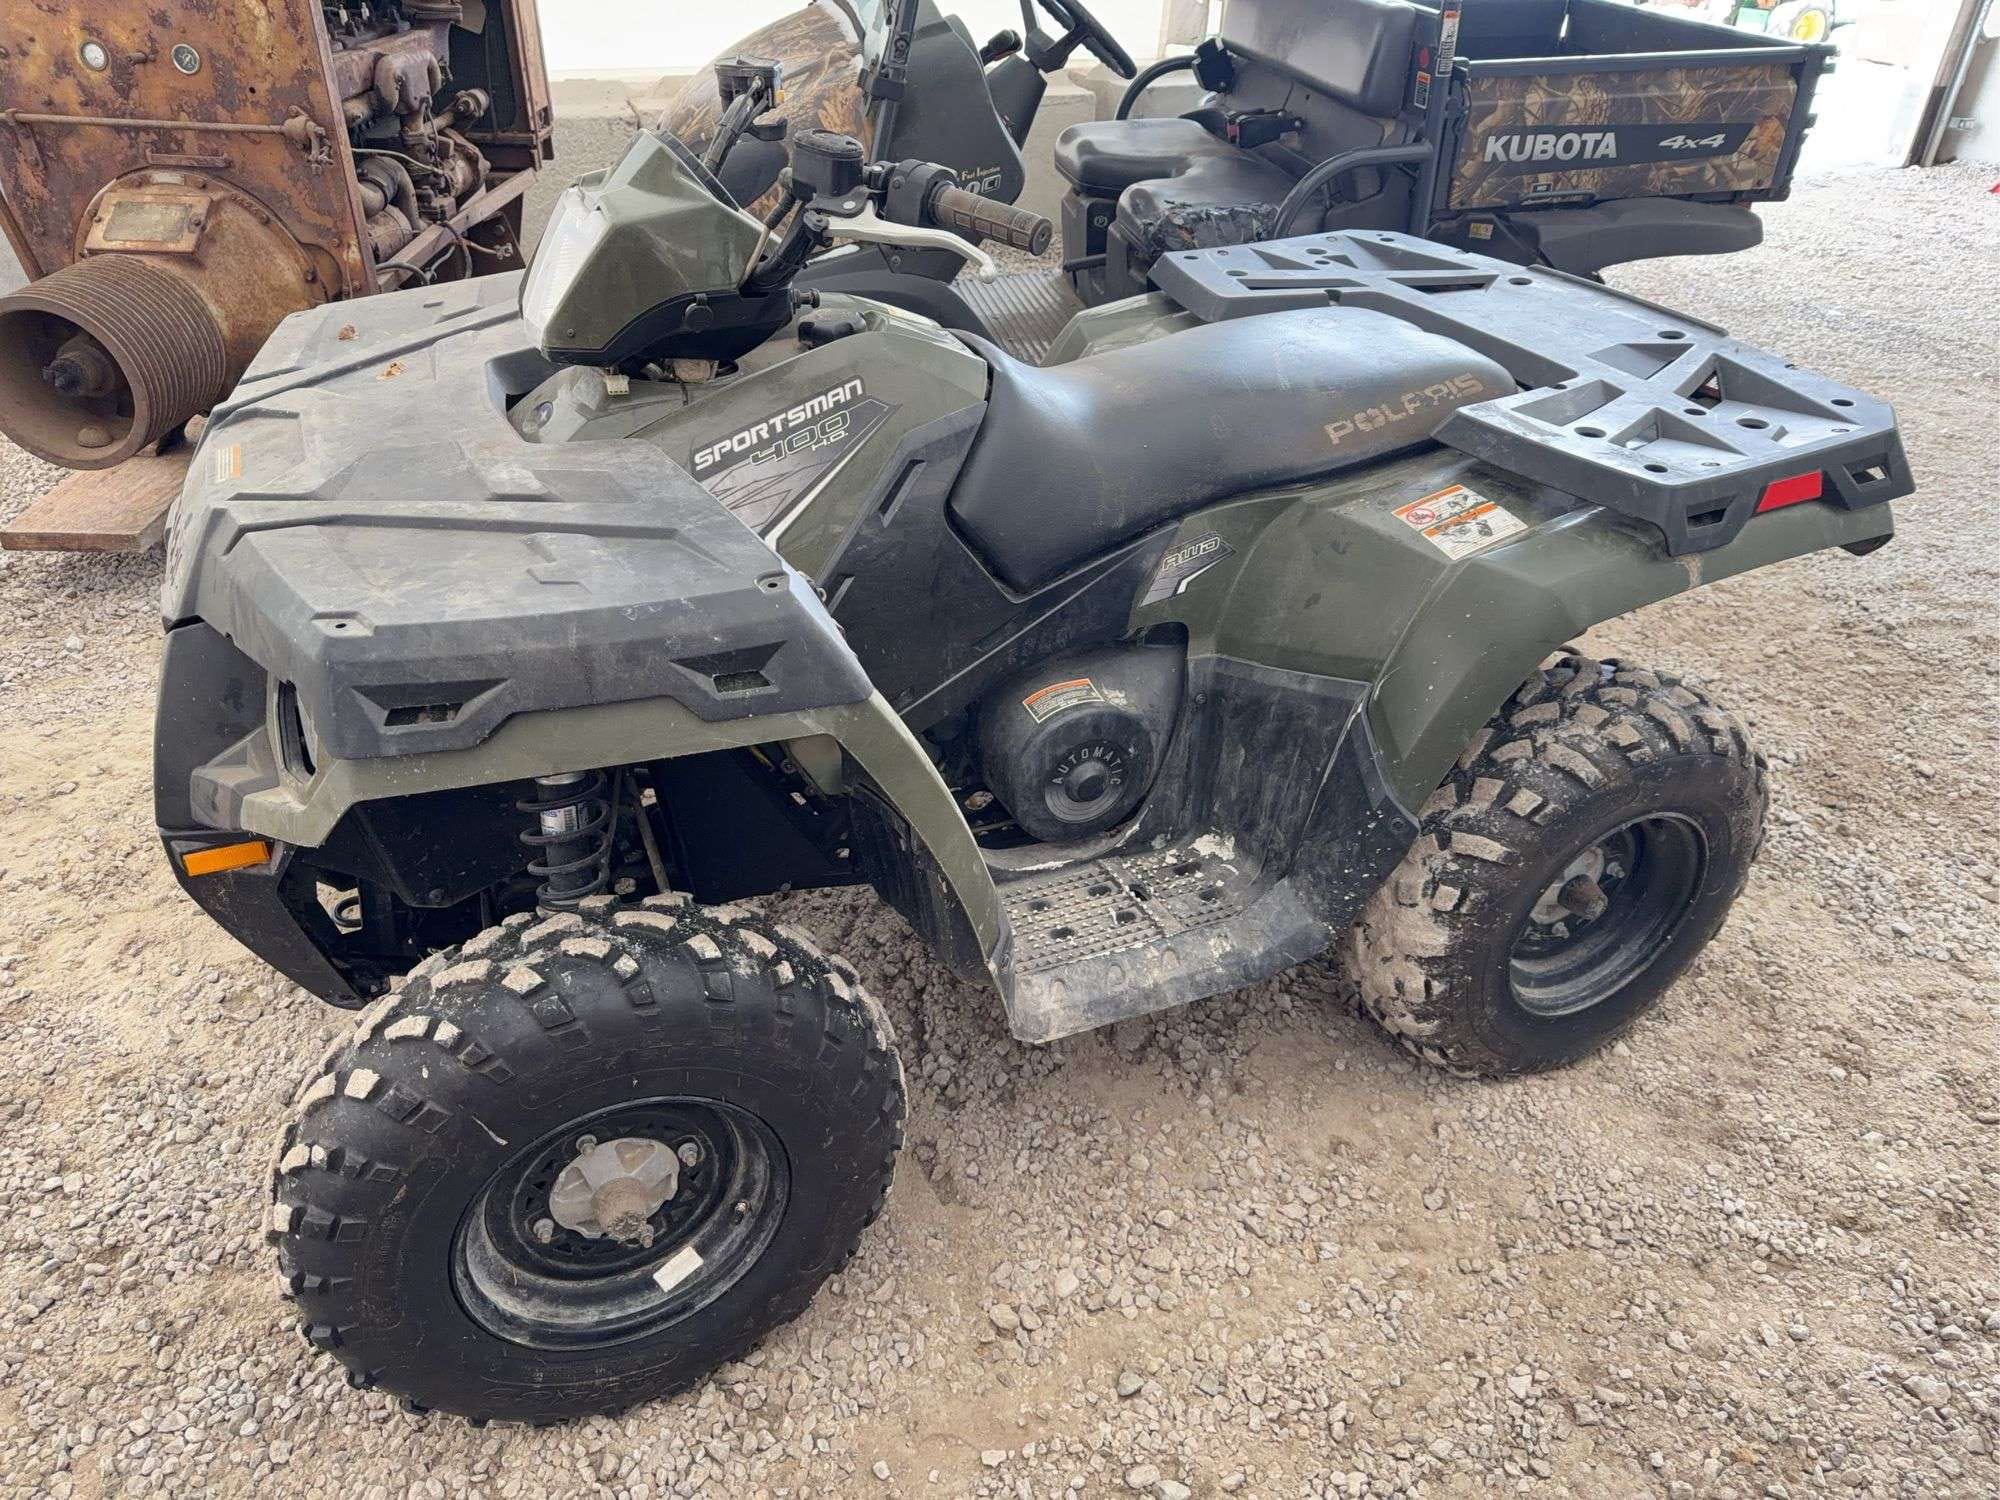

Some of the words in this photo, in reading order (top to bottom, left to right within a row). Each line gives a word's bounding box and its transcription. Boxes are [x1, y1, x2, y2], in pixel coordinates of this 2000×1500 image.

[1484, 132, 1618, 162] KUBOTA
[1658, 133, 1727, 149] 4x4
[694, 378, 863, 471] SPORTSMAN
[749, 410, 850, 466] 400
[1051, 746, 1123, 785] AUTOMATIC
